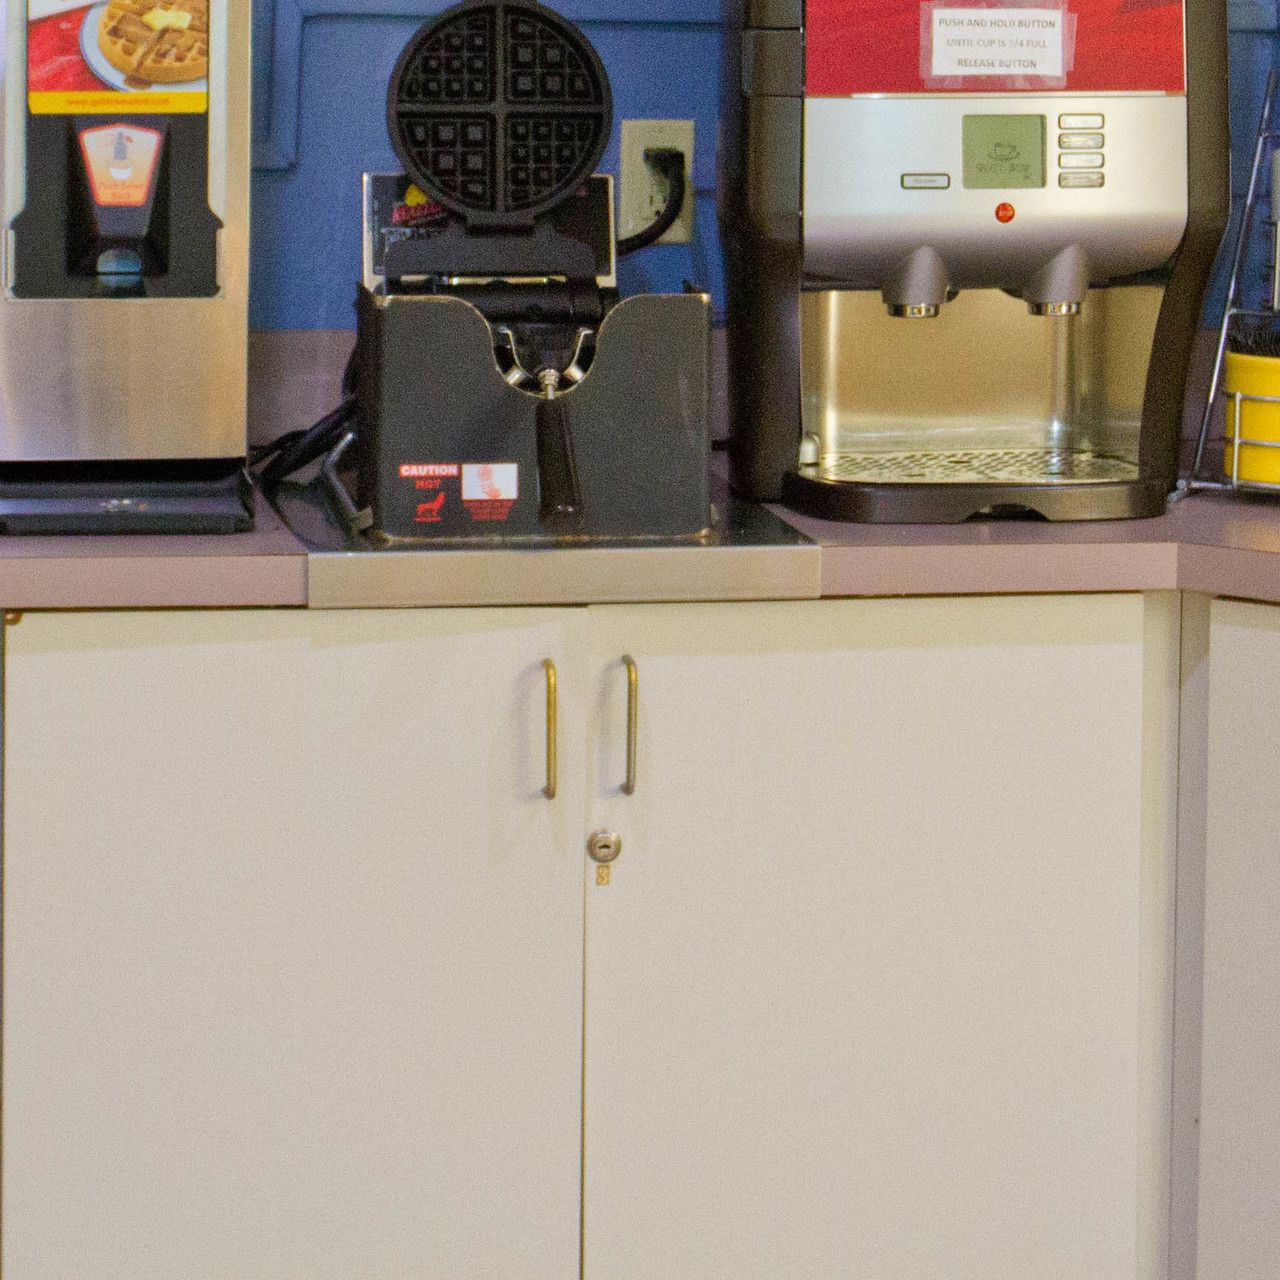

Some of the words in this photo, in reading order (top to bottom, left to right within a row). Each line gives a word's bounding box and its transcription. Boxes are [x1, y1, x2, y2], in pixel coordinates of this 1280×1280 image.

[938, 18, 965, 27] PUSH
[966, 18, 987, 28] AND
[990, 19, 1015, 28] HOLD
[1017, 19, 1056, 29] BUTTON
[946, 38, 974, 48] UNTIL
[976, 38, 996, 48] CUP
[997, 38, 1006, 48] IS
[1026, 39, 1048, 49] FULL
[957, 58, 997, 68] RELEASE
[998, 59, 1037, 69] BUTTON
[400, 465, 458, 476] CAUTION
